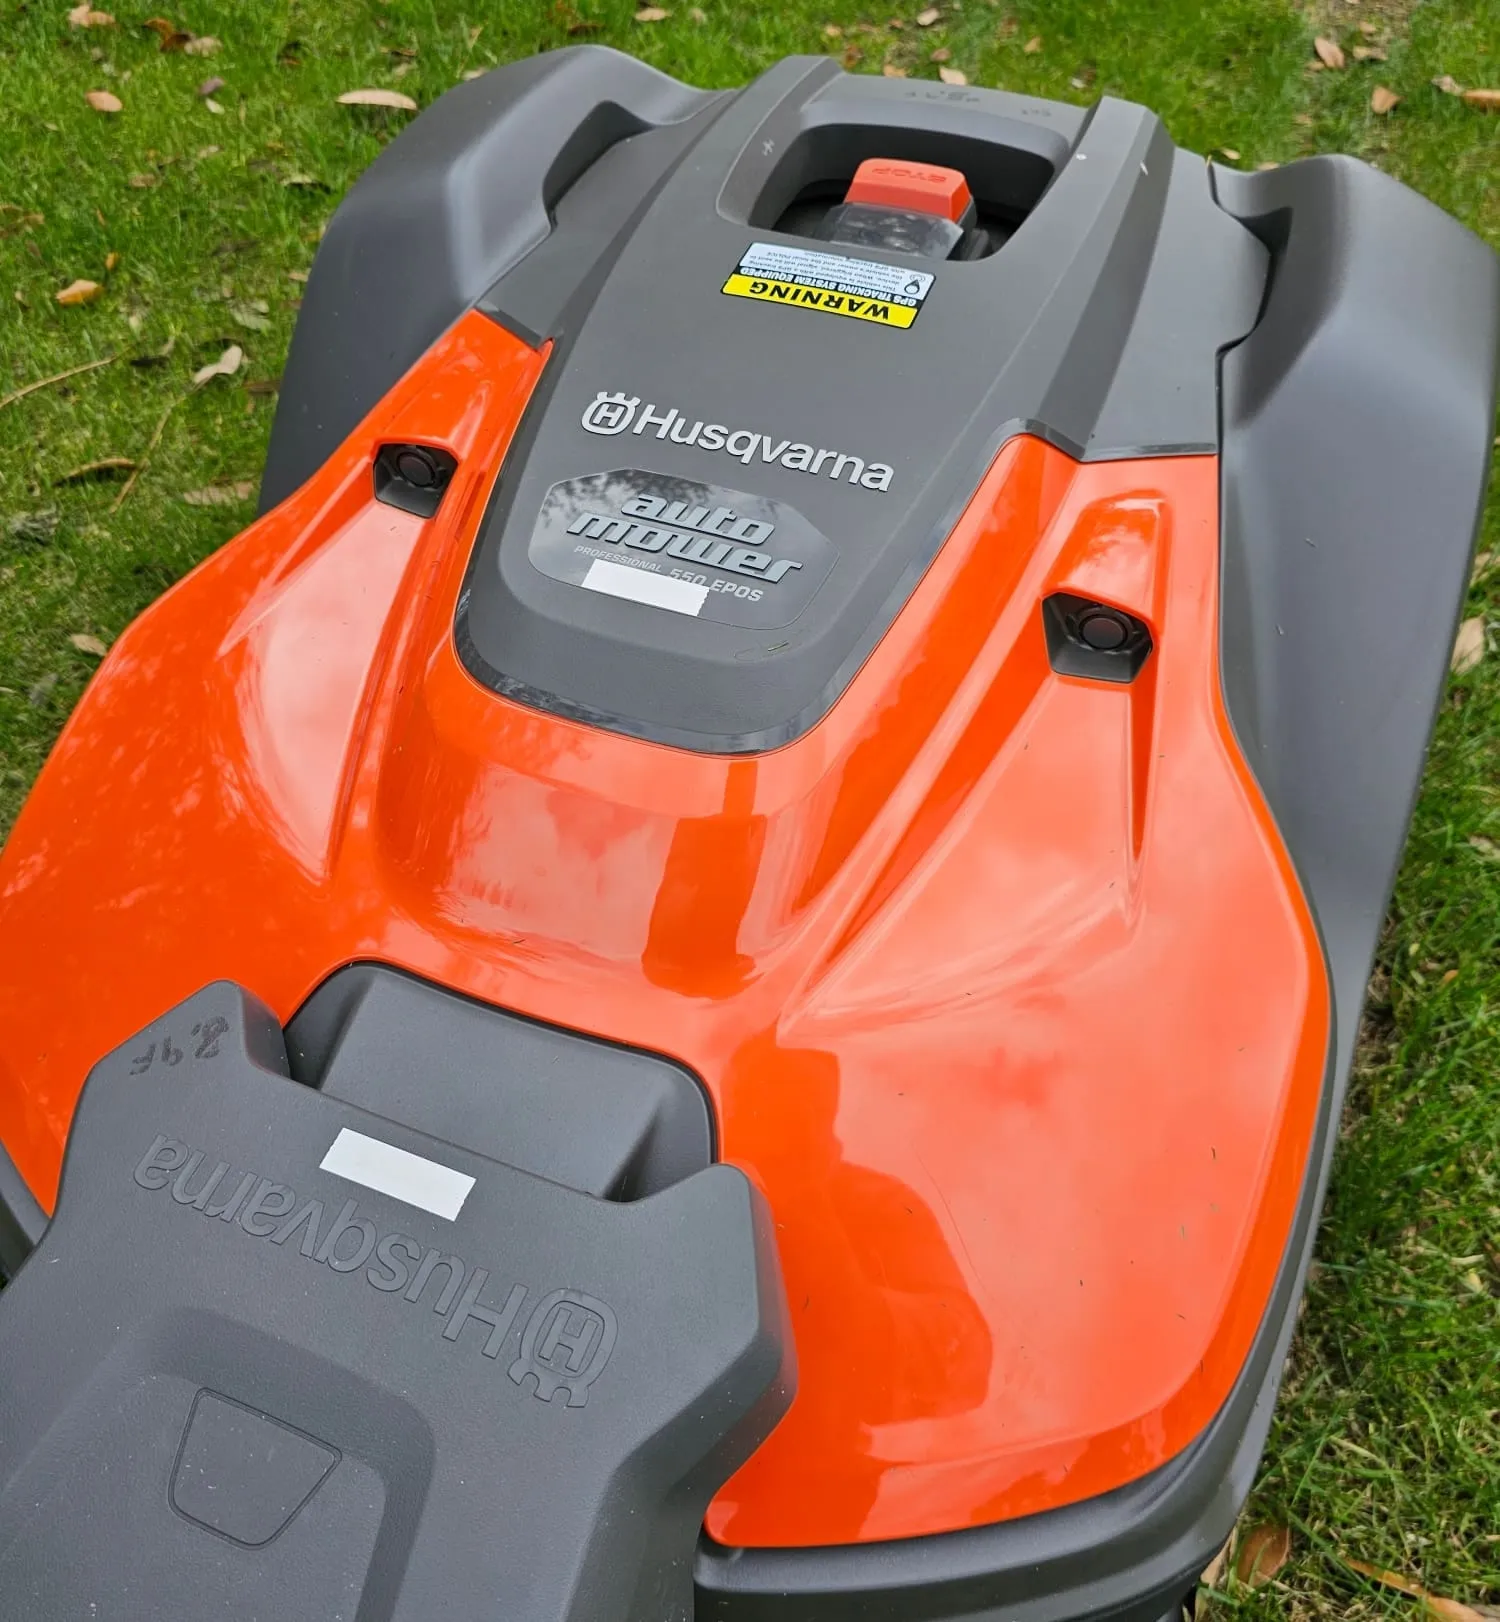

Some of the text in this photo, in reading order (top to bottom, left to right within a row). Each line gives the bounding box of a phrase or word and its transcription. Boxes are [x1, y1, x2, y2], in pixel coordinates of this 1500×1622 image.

[872, 166, 947, 184] STOP
[738, 265, 917, 306] GPS TRACKING SYSTEM EQUIPPED
[747, 280, 893, 319] WARNING
[632, 404, 894, 492] Husqvarna
[621, 494, 775, 546] auto
[566, 512, 803, 583] mower
[574, 545, 764, 602] PROFESSIONAL 550 EPOS
[133, 1134, 528, 1359] Husqvarna
